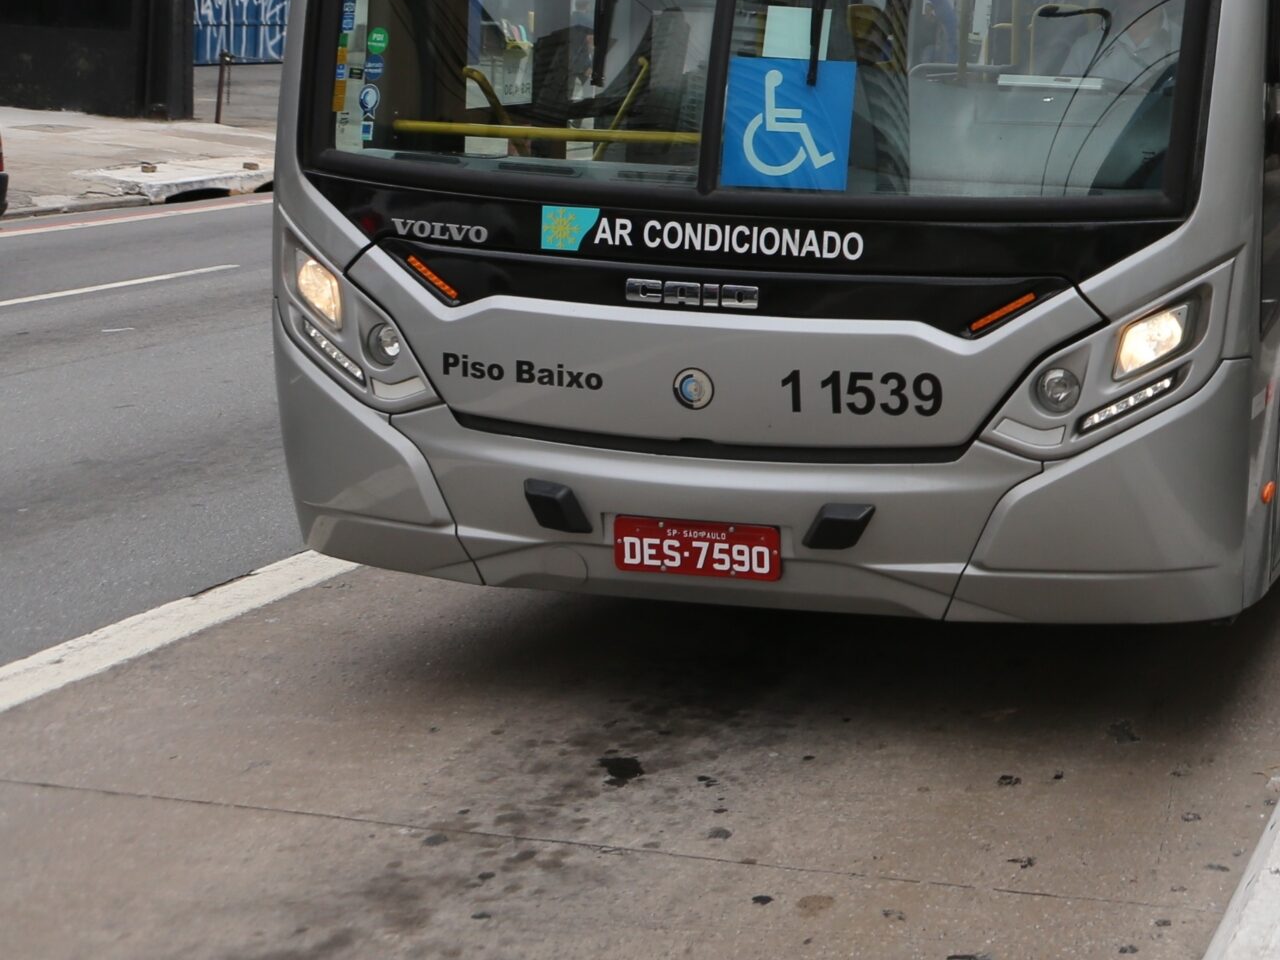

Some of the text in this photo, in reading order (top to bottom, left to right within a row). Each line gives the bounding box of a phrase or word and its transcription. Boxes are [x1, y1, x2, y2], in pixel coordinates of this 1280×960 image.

[391, 218, 488, 243] VOLVO
[594, 217, 864, 261] AR CONDICIONADO
[625, 278, 759, 309] CAIO
[442, 352, 603, 390] Piso Baixo
